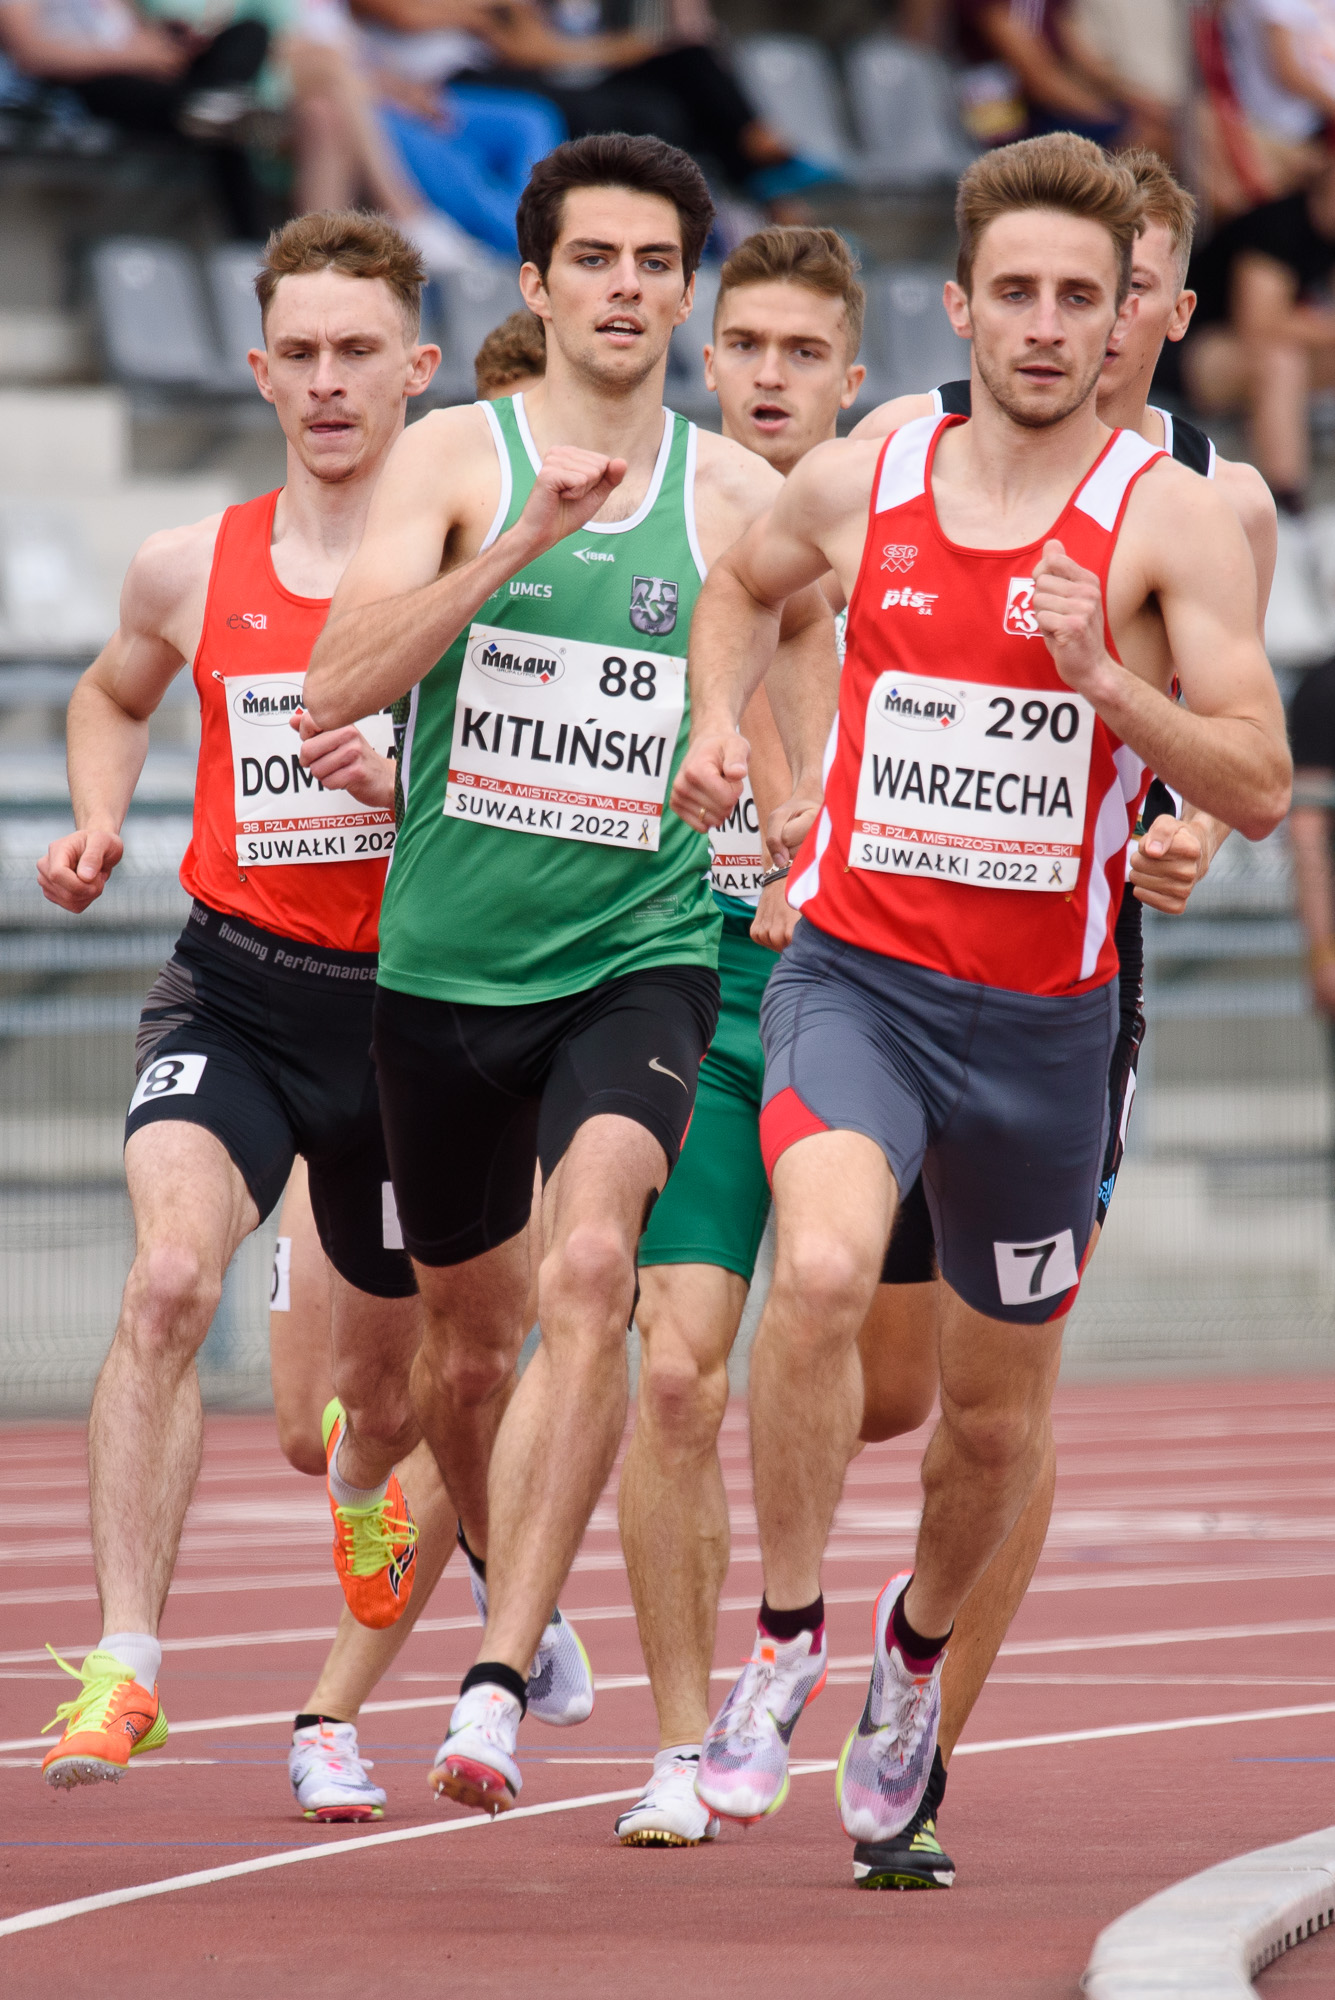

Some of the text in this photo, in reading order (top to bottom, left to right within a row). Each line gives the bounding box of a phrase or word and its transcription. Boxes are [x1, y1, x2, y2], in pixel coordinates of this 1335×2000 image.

[509, 582, 553, 598] UMCS
[881, 587, 929, 610] pts
[481, 649, 557, 677] MALOW
[599, 656, 656, 701] 88
[884, 694, 956, 720] MALOW
[985, 697, 1080, 744] 290
[461, 707, 667, 778] KITLIŃSKI
[456, 772, 659, 815] 98. PZLA MISTRZOSTWA POLSKI
[872, 754, 1073, 818] WARZECHA
[243, 811, 393, 834] 98. PZLA MISTRZOSTWA
[456, 793, 630, 840] SUWAŁKI 2022
[247, 830, 396, 861] SUWAŁKI 202
[861, 822, 1074, 857] 98. PZLA MISTRZOSTWA POLSKI
[861, 843, 1038, 883] SUWAŁKI 2022
[218, 921, 377, 981] Running Performance
[143, 1060, 185, 1097] 8
[1013, 1241, 1057, 1296] 7
